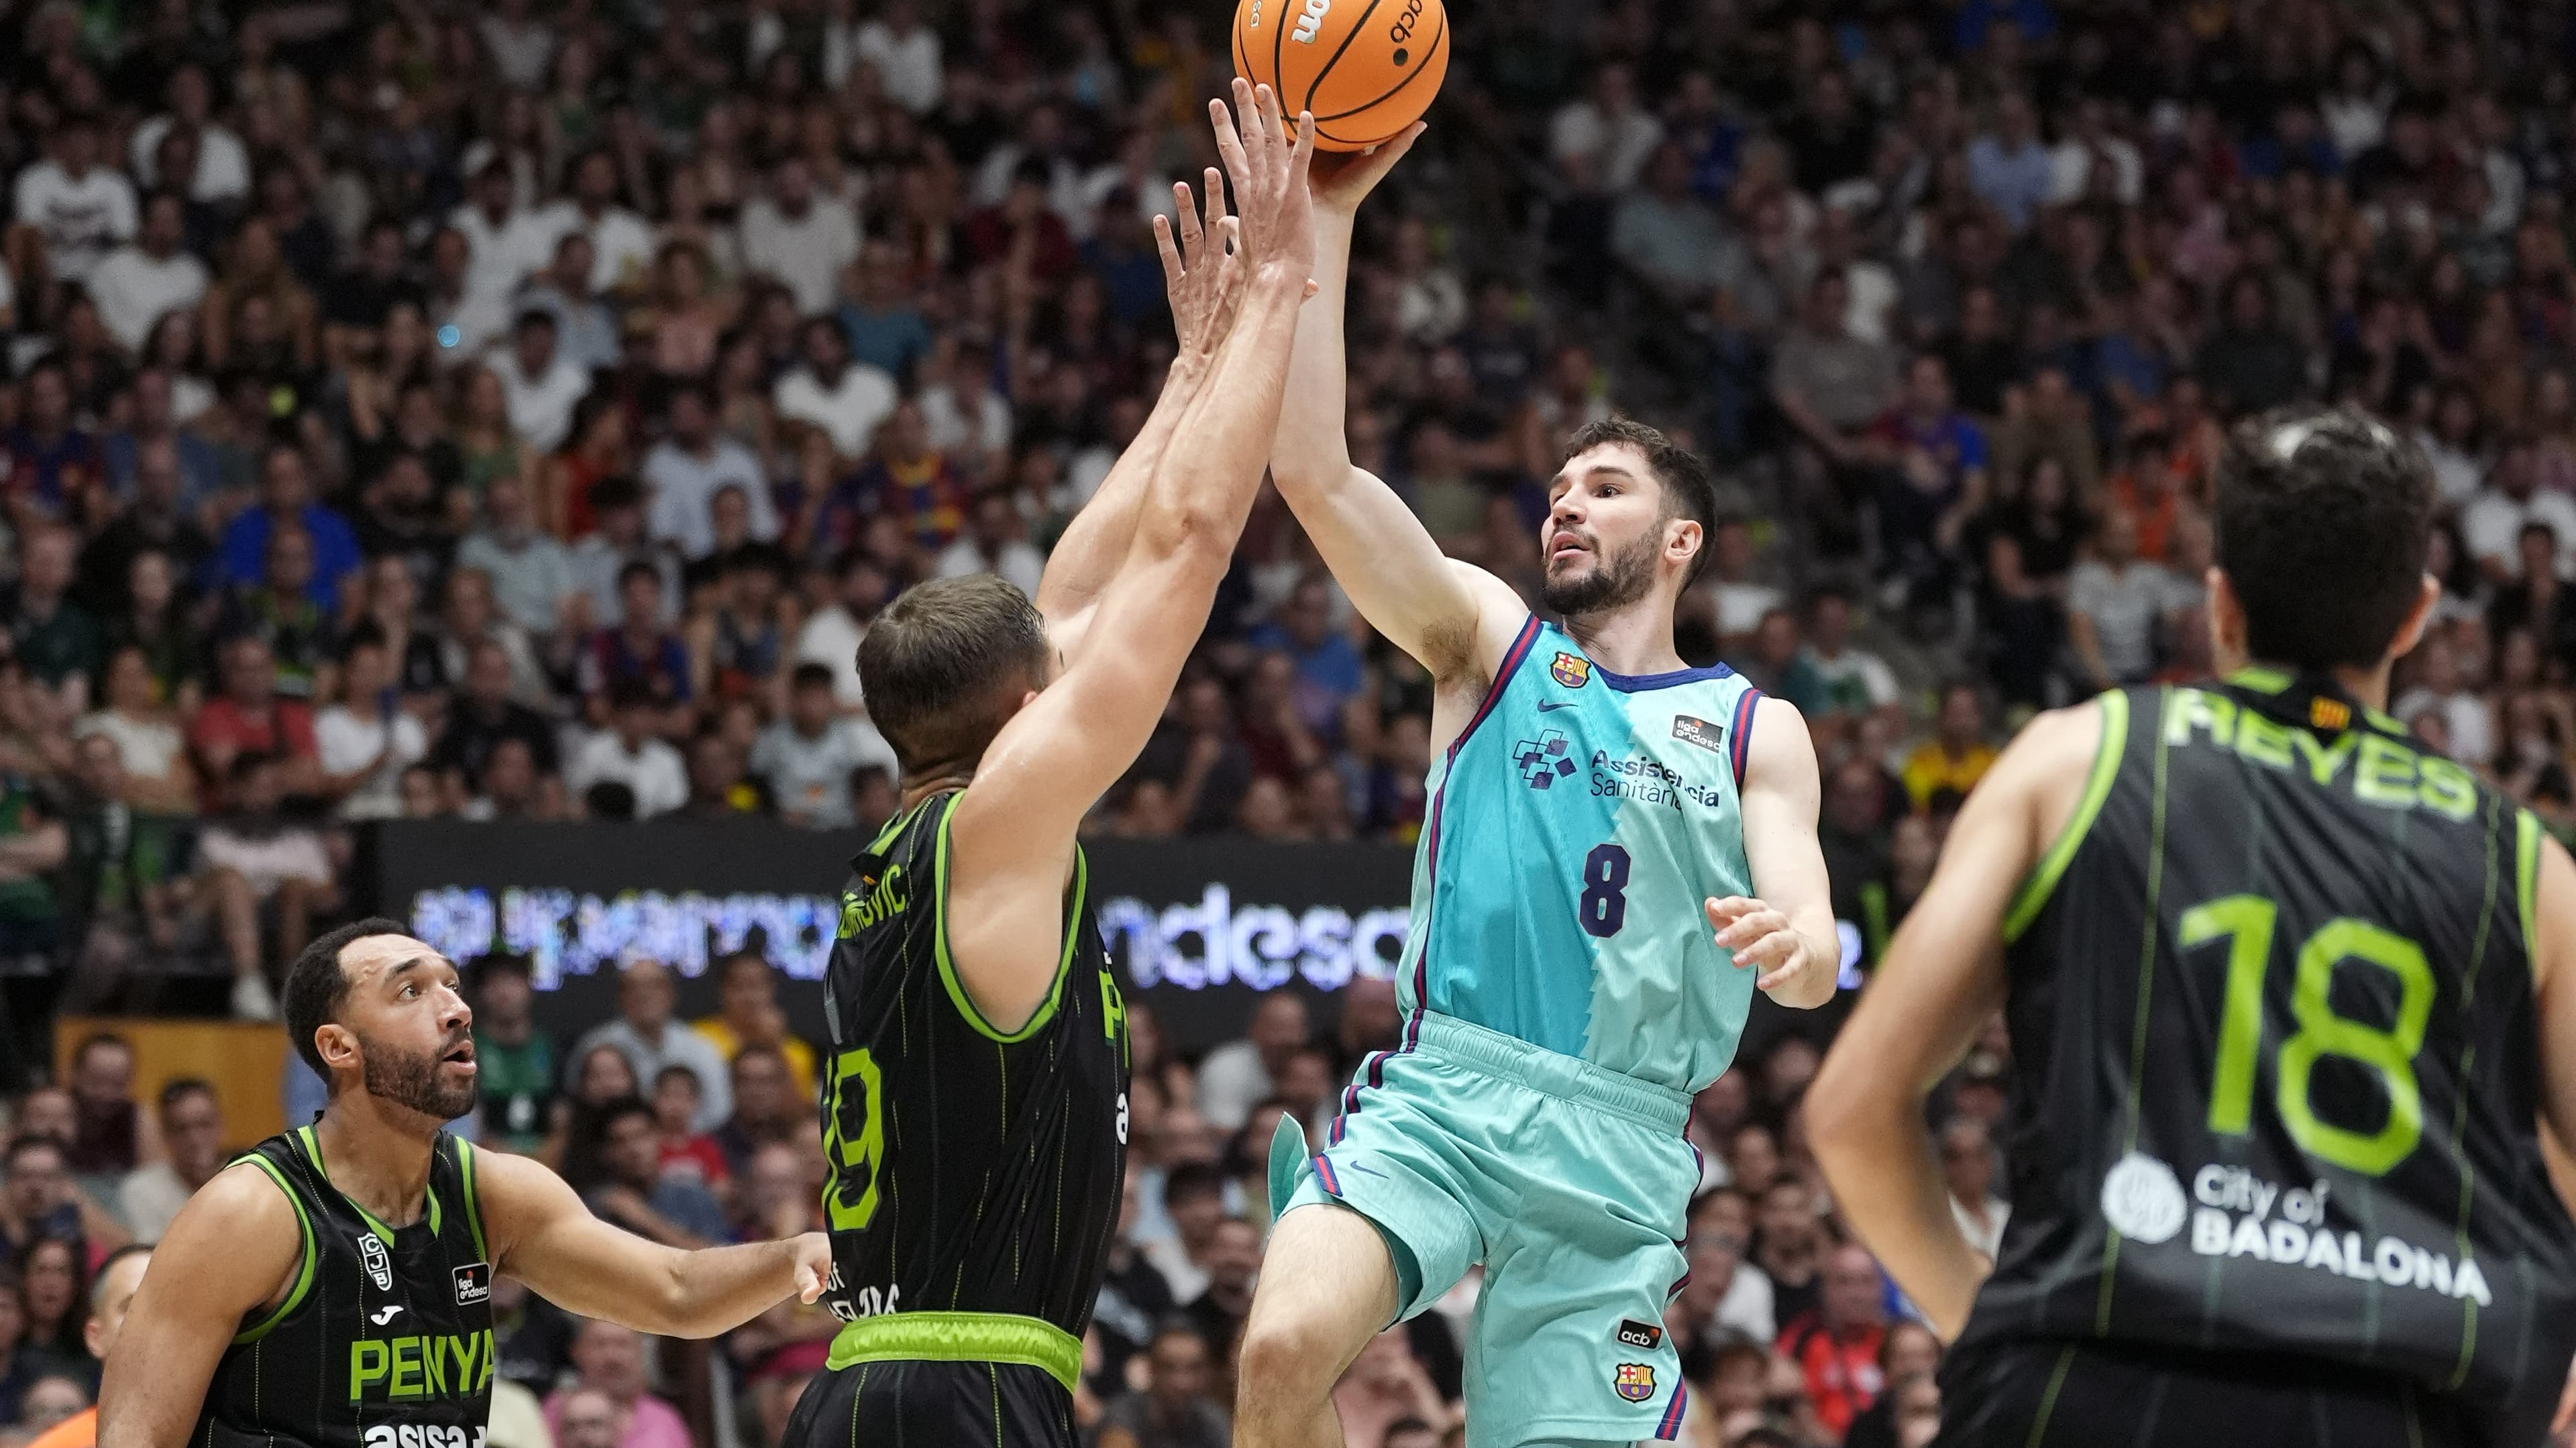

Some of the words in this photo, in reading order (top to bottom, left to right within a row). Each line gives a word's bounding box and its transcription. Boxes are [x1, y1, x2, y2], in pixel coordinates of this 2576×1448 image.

[1678, 720, 1699, 734] liga
[2164, 688, 2478, 822] REYES
[1580, 844, 1631, 938] 8
[2178, 893, 2437, 1177] 18
[2193, 1163, 2279, 1221] City
[2282, 1178, 2332, 1227] of
[458, 1278, 473, 1290] liga
[2190, 1207, 2493, 1306] BADALONA
[460, 1286, 488, 1300] endesa
[1621, 1330, 1650, 1346] acb
